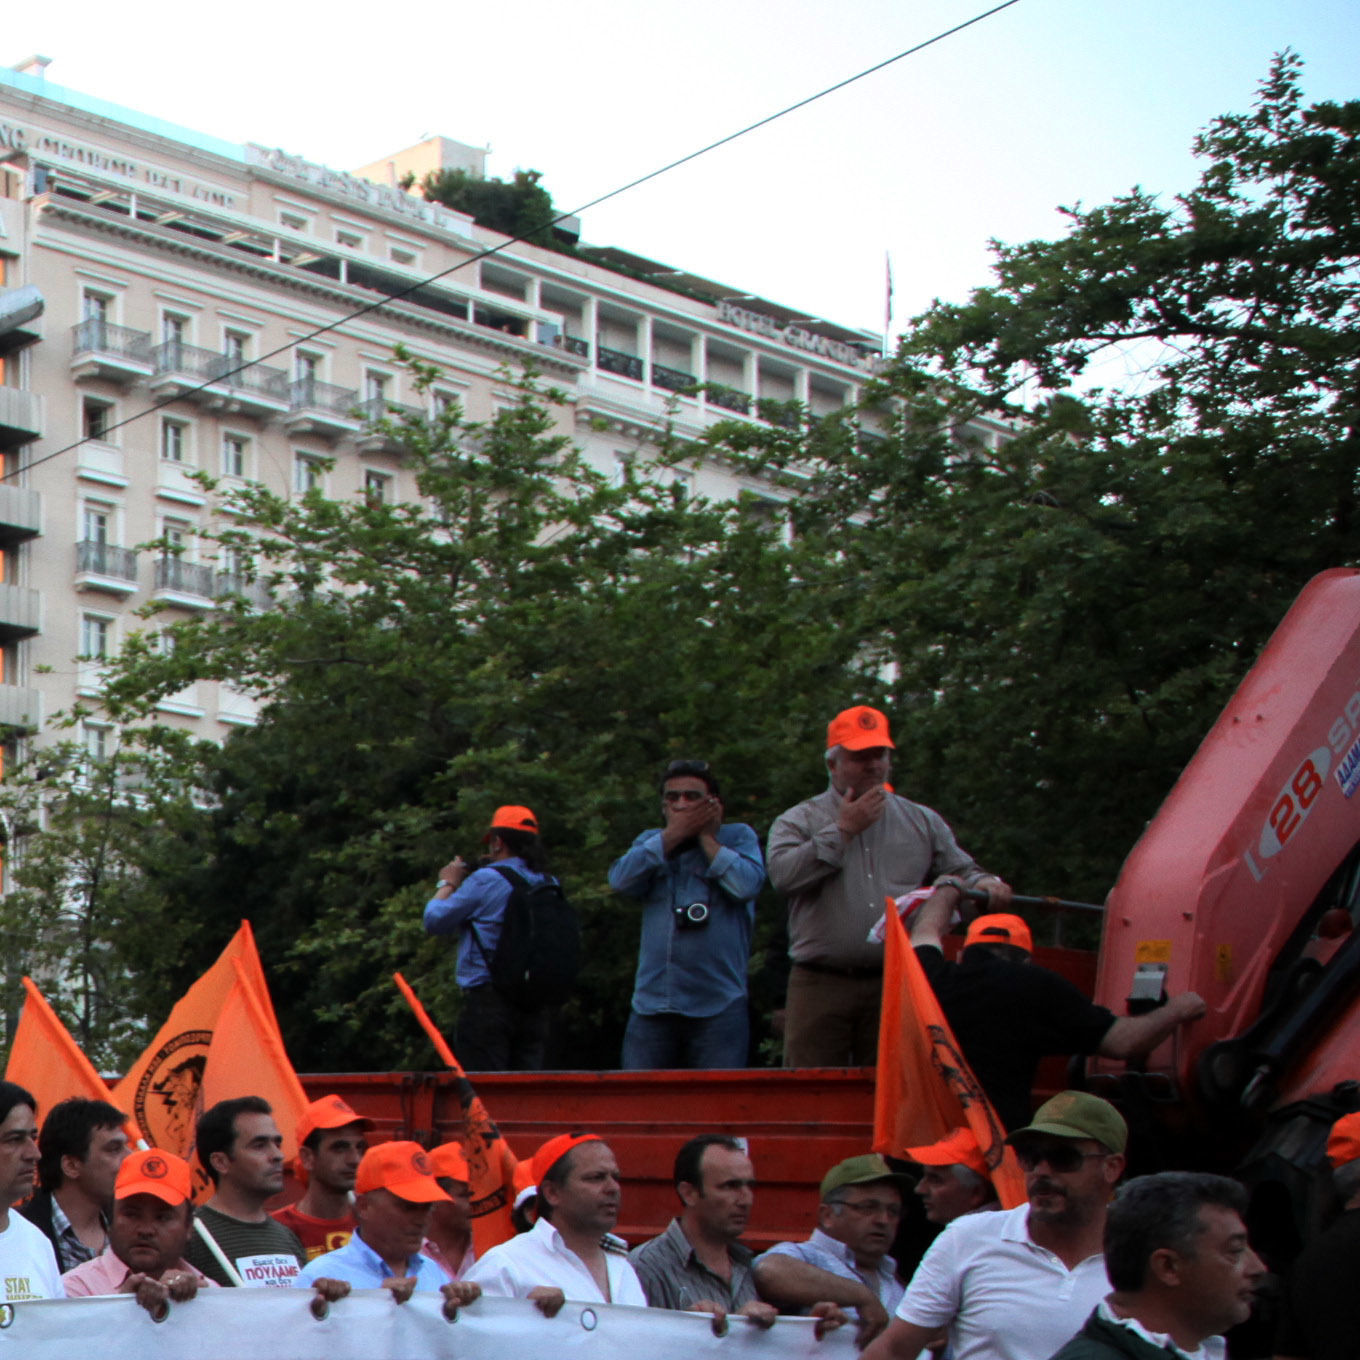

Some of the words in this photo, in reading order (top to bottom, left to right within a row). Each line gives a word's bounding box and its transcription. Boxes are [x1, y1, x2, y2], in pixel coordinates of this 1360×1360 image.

[1270, 758, 1323, 846] 28
[244, 1265, 299, 1281] ΠΟΥΛΑΜΕ
[5, 1277, 31, 1294] STAY
